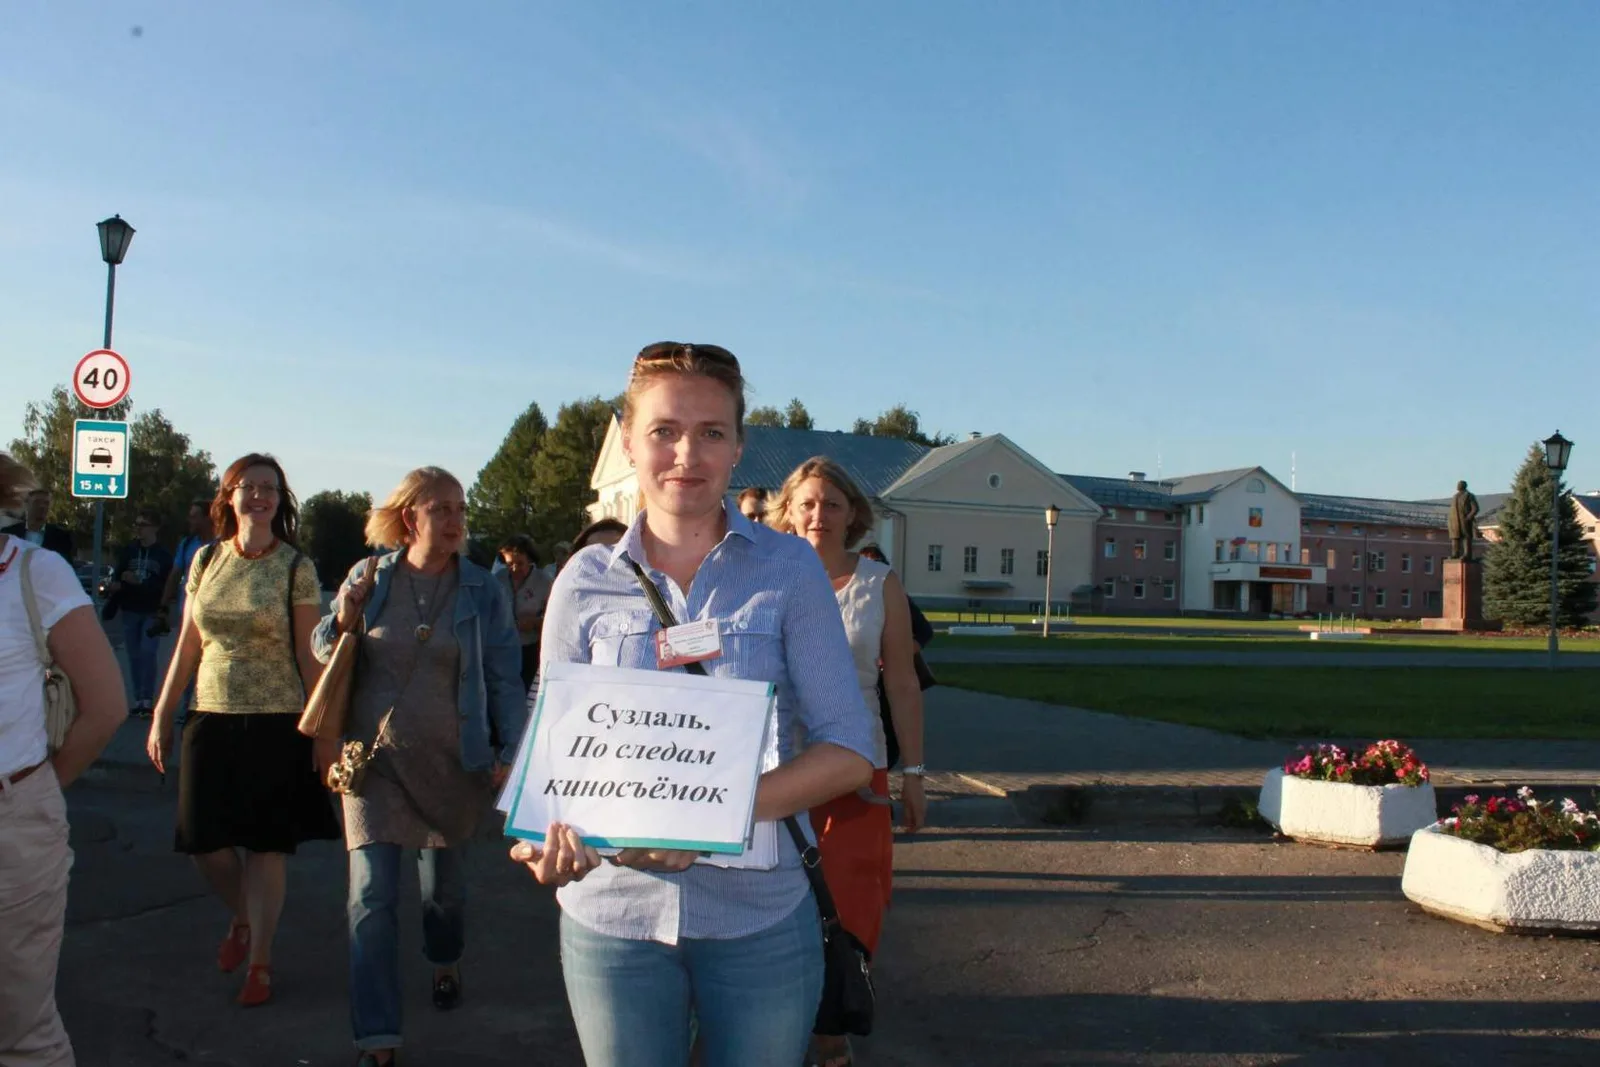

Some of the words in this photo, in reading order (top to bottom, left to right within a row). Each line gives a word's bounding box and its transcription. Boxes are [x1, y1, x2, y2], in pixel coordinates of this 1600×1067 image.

[83, 367, 118, 390] 40
[80, 480, 92, 491] 15
[587, 702, 711, 731] Суздаль.
[567, 735, 608, 758] По
[615, 741, 716, 765] следам
[543, 776, 728, 804] киносъёмок
